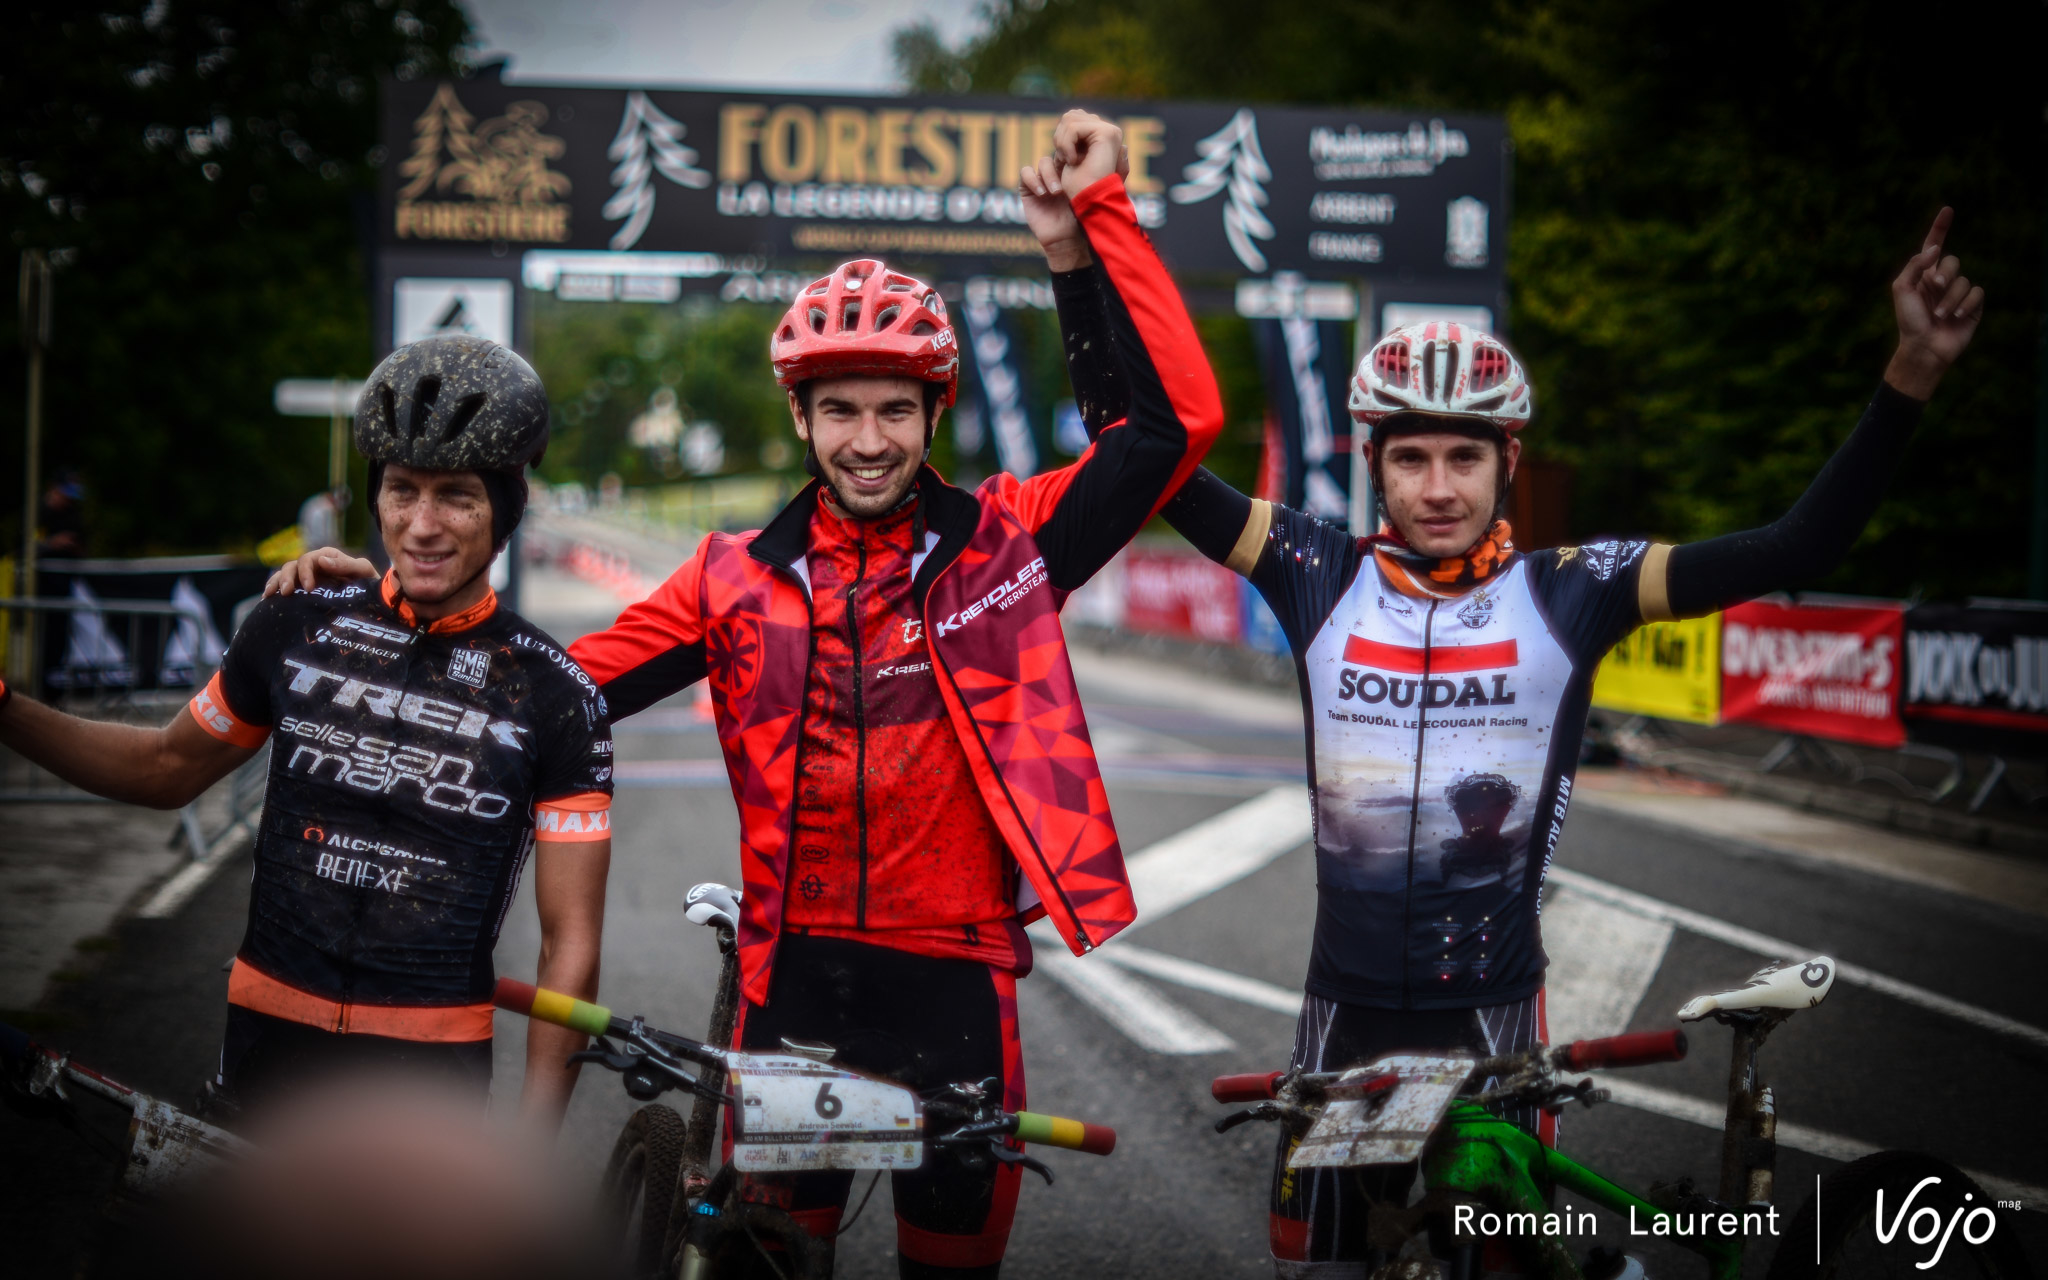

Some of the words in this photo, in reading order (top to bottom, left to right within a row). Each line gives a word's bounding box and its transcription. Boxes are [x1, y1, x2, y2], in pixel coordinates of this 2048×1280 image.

[931, 329, 953, 351] KED
[936, 556, 1046, 638] KREIDLER
[330, 636, 400, 660] BONTRAGER
[452, 648, 489, 679] SMS
[509, 632, 597, 698] AUTOVEGA
[451, 670, 481, 685] Santini
[1338, 668, 1516, 708] SOUDAL
[283, 658, 529, 751] TREK
[1328, 710, 1349, 722] Team
[1351, 713, 1399, 728] SOUDAL
[1489, 717, 1528, 727] Racing
[279, 716, 356, 748] selle
[350, 736, 474, 786] san
[288, 744, 511, 819] marco
[1554, 775, 1572, 820] MTB
[814, 1082, 843, 1120] 6
[797, 1122, 829, 1130] Andreas
[830, 1121, 863, 1130] Seewald
